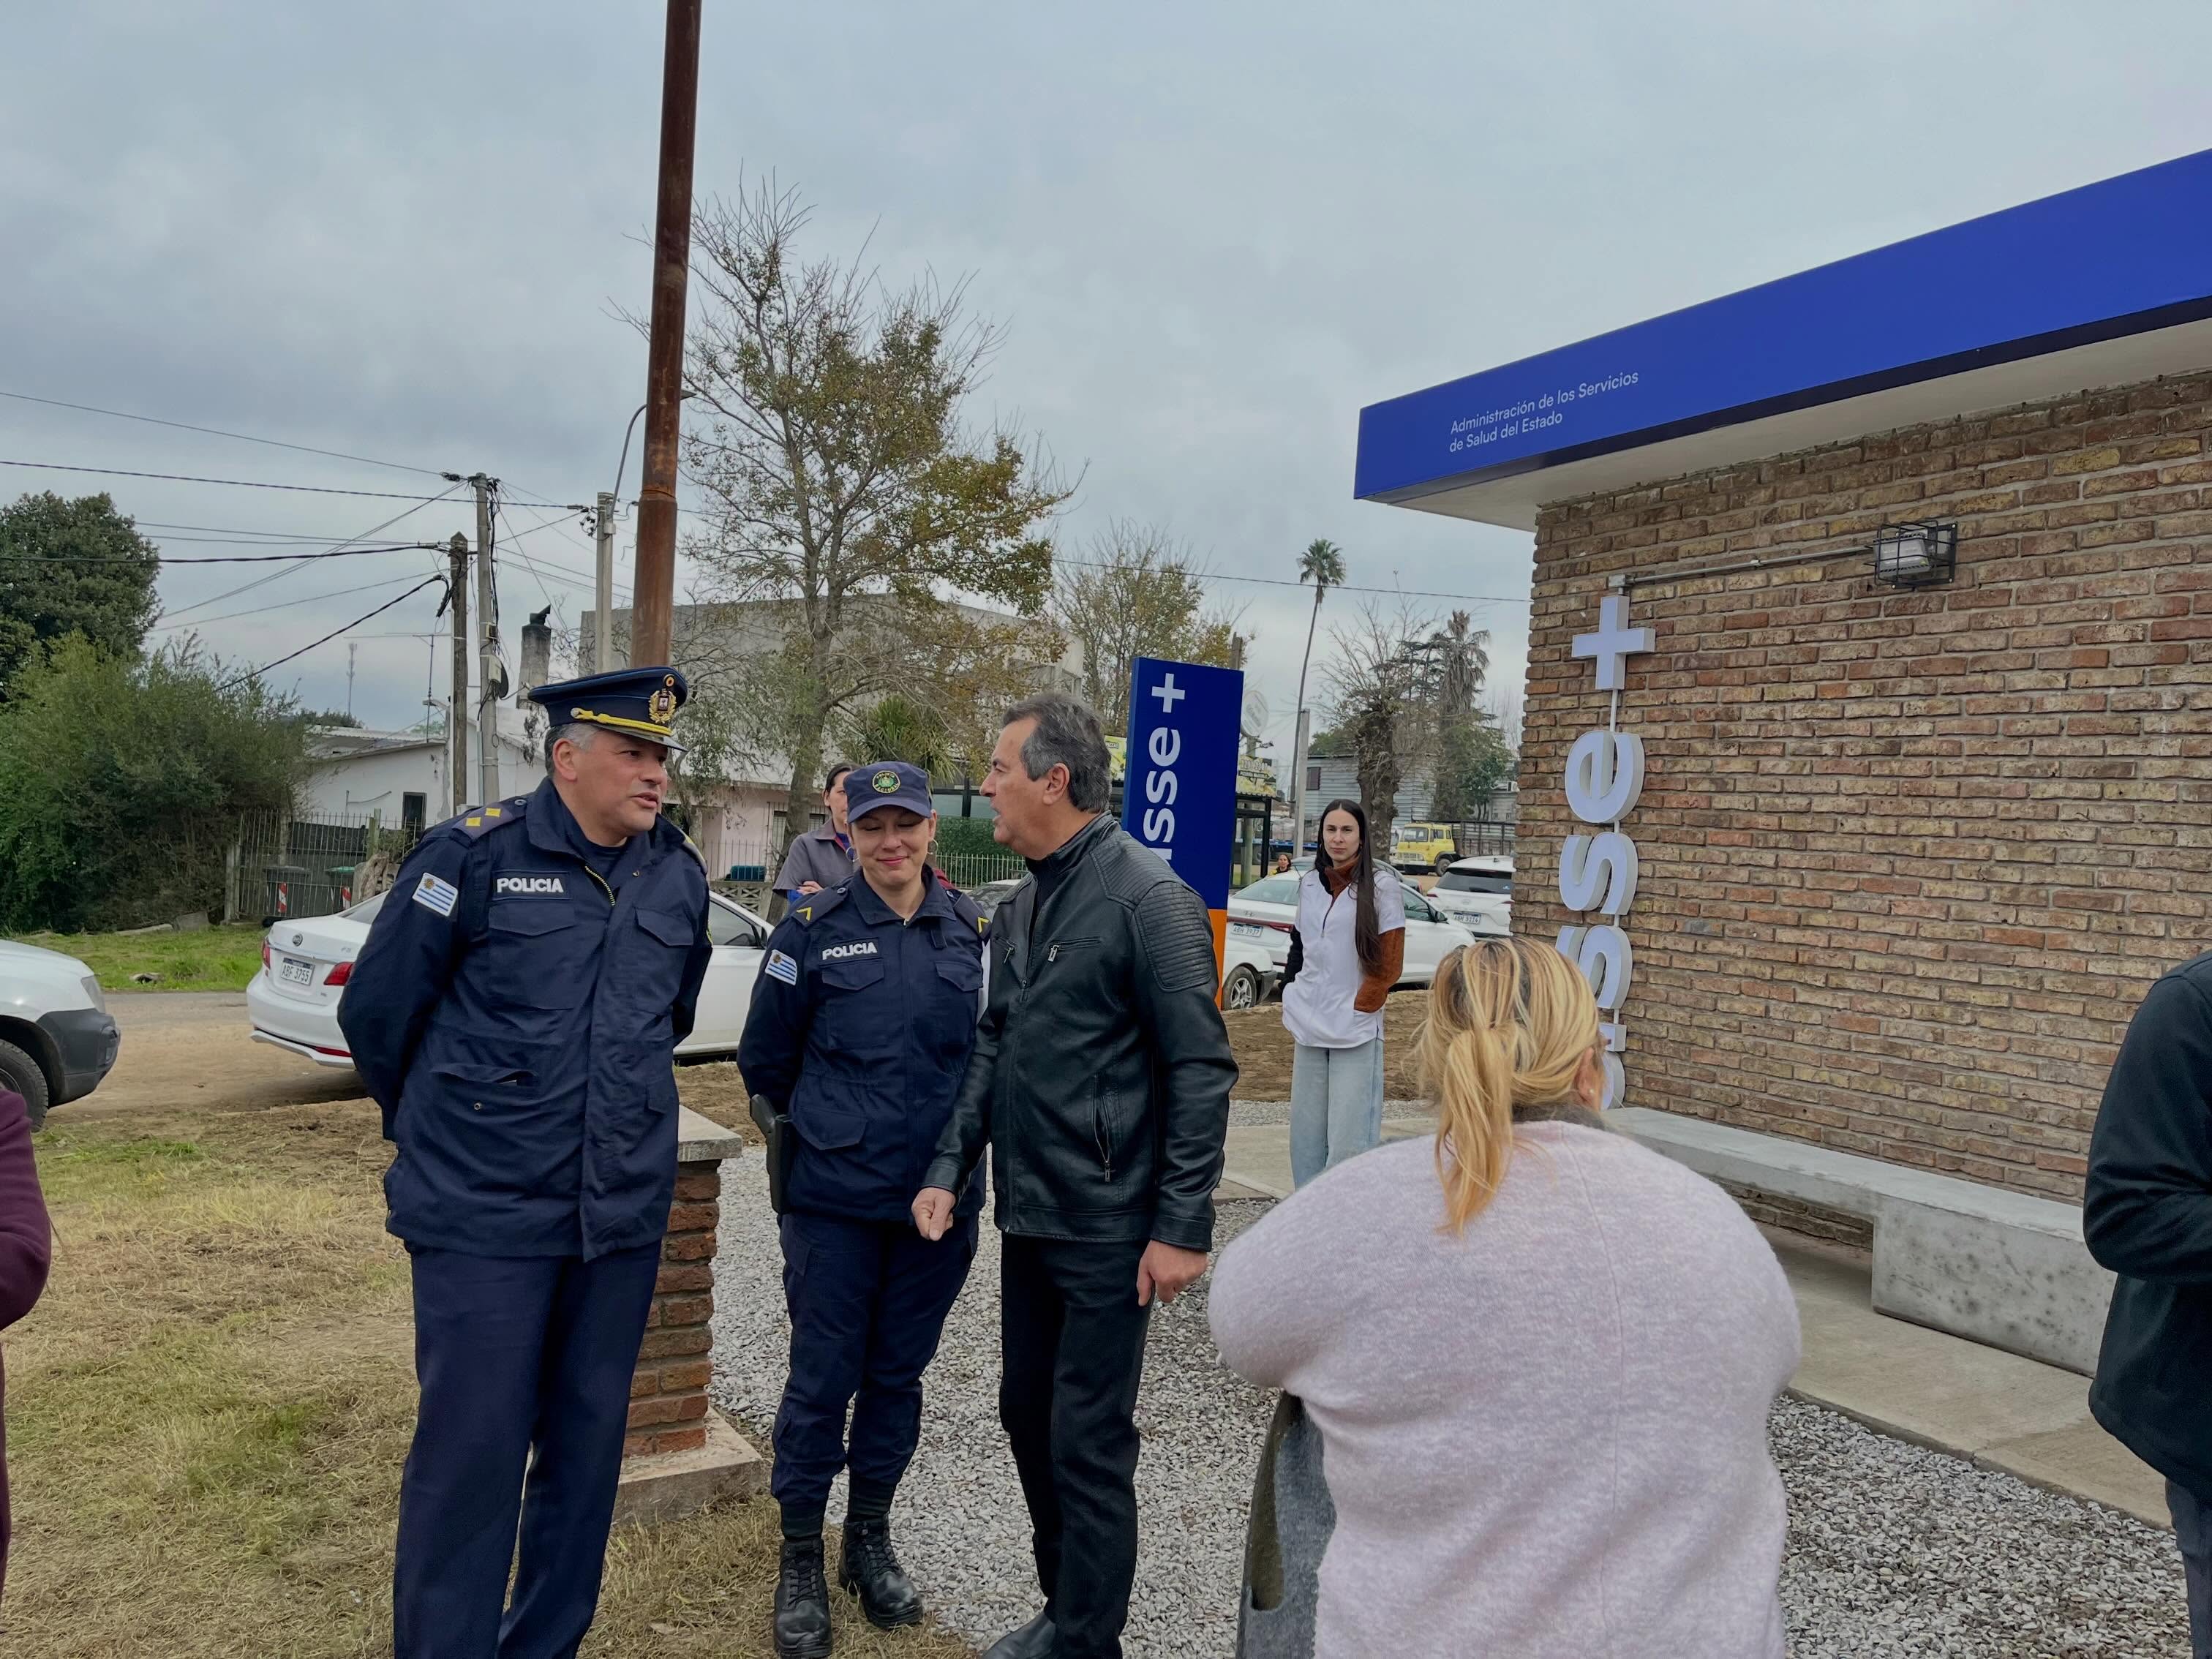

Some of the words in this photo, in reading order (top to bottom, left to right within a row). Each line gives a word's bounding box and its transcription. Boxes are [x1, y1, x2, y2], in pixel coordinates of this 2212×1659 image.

[1451, 400, 1535, 434] Administración
[1538, 394, 1554, 409] de
[1557, 389, 1575, 404] los
[1579, 372, 1639, 398] Servicios
[1449, 438, 1463, 452] de
[1466, 427, 1497, 448] Salud
[1500, 423, 1519, 439] del
[1521, 411, 1563, 433] Estado
[496, 877, 564, 893] POLICIA
[822, 941, 878, 960] POLICIA
[282, 964, 293, 978] ABF
[294, 967, 311, 983] 3755
